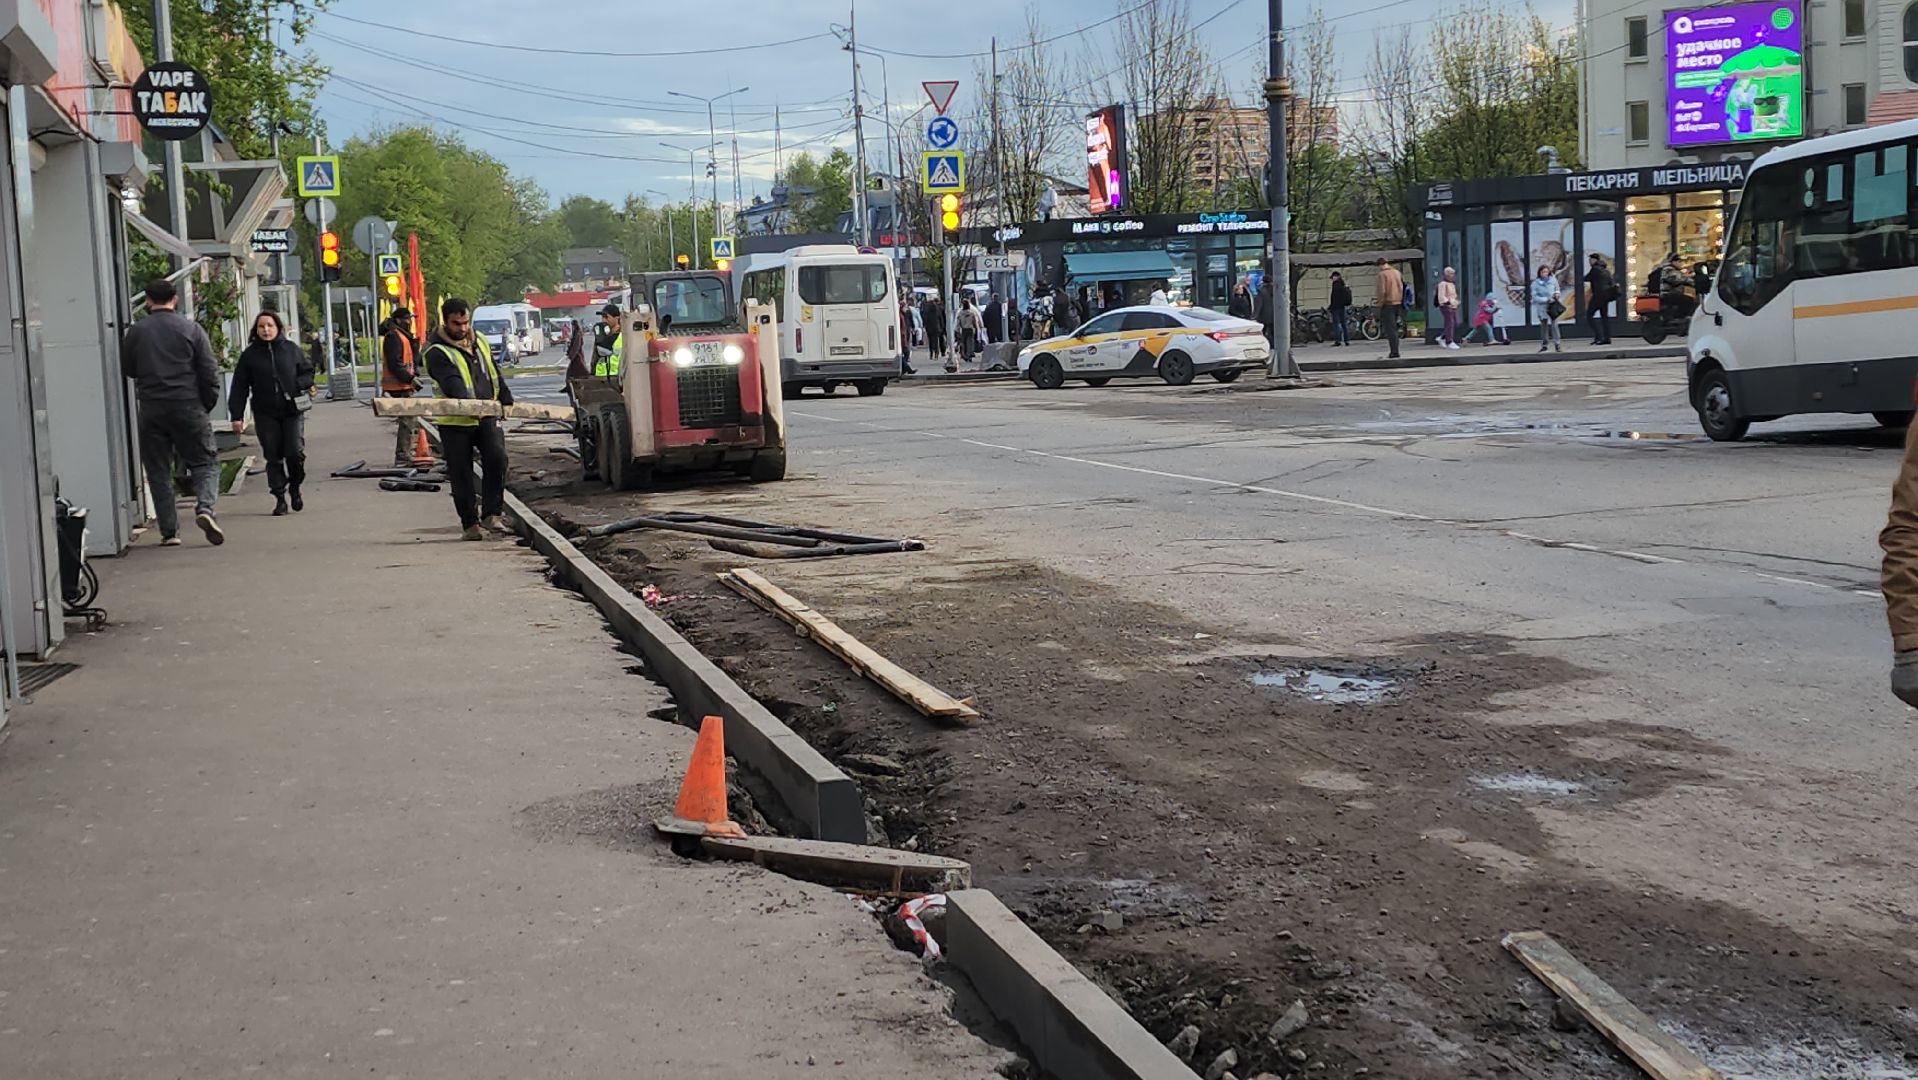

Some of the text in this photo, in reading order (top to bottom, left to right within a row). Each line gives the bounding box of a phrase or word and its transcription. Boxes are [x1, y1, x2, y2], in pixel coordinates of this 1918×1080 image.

[148, 71, 195, 88] VAPE
[137, 91, 208, 114] ТАБАК
[1566, 164, 1744, 192] ПЕКАРНЯ МЕЛЬНИЦА
[1177, 220, 1270, 233] РЕМОНТ ТЕЛЕФОНОВ
[253, 230, 288, 240] ТАБАК
[984, 258, 1008, 268] СТО
